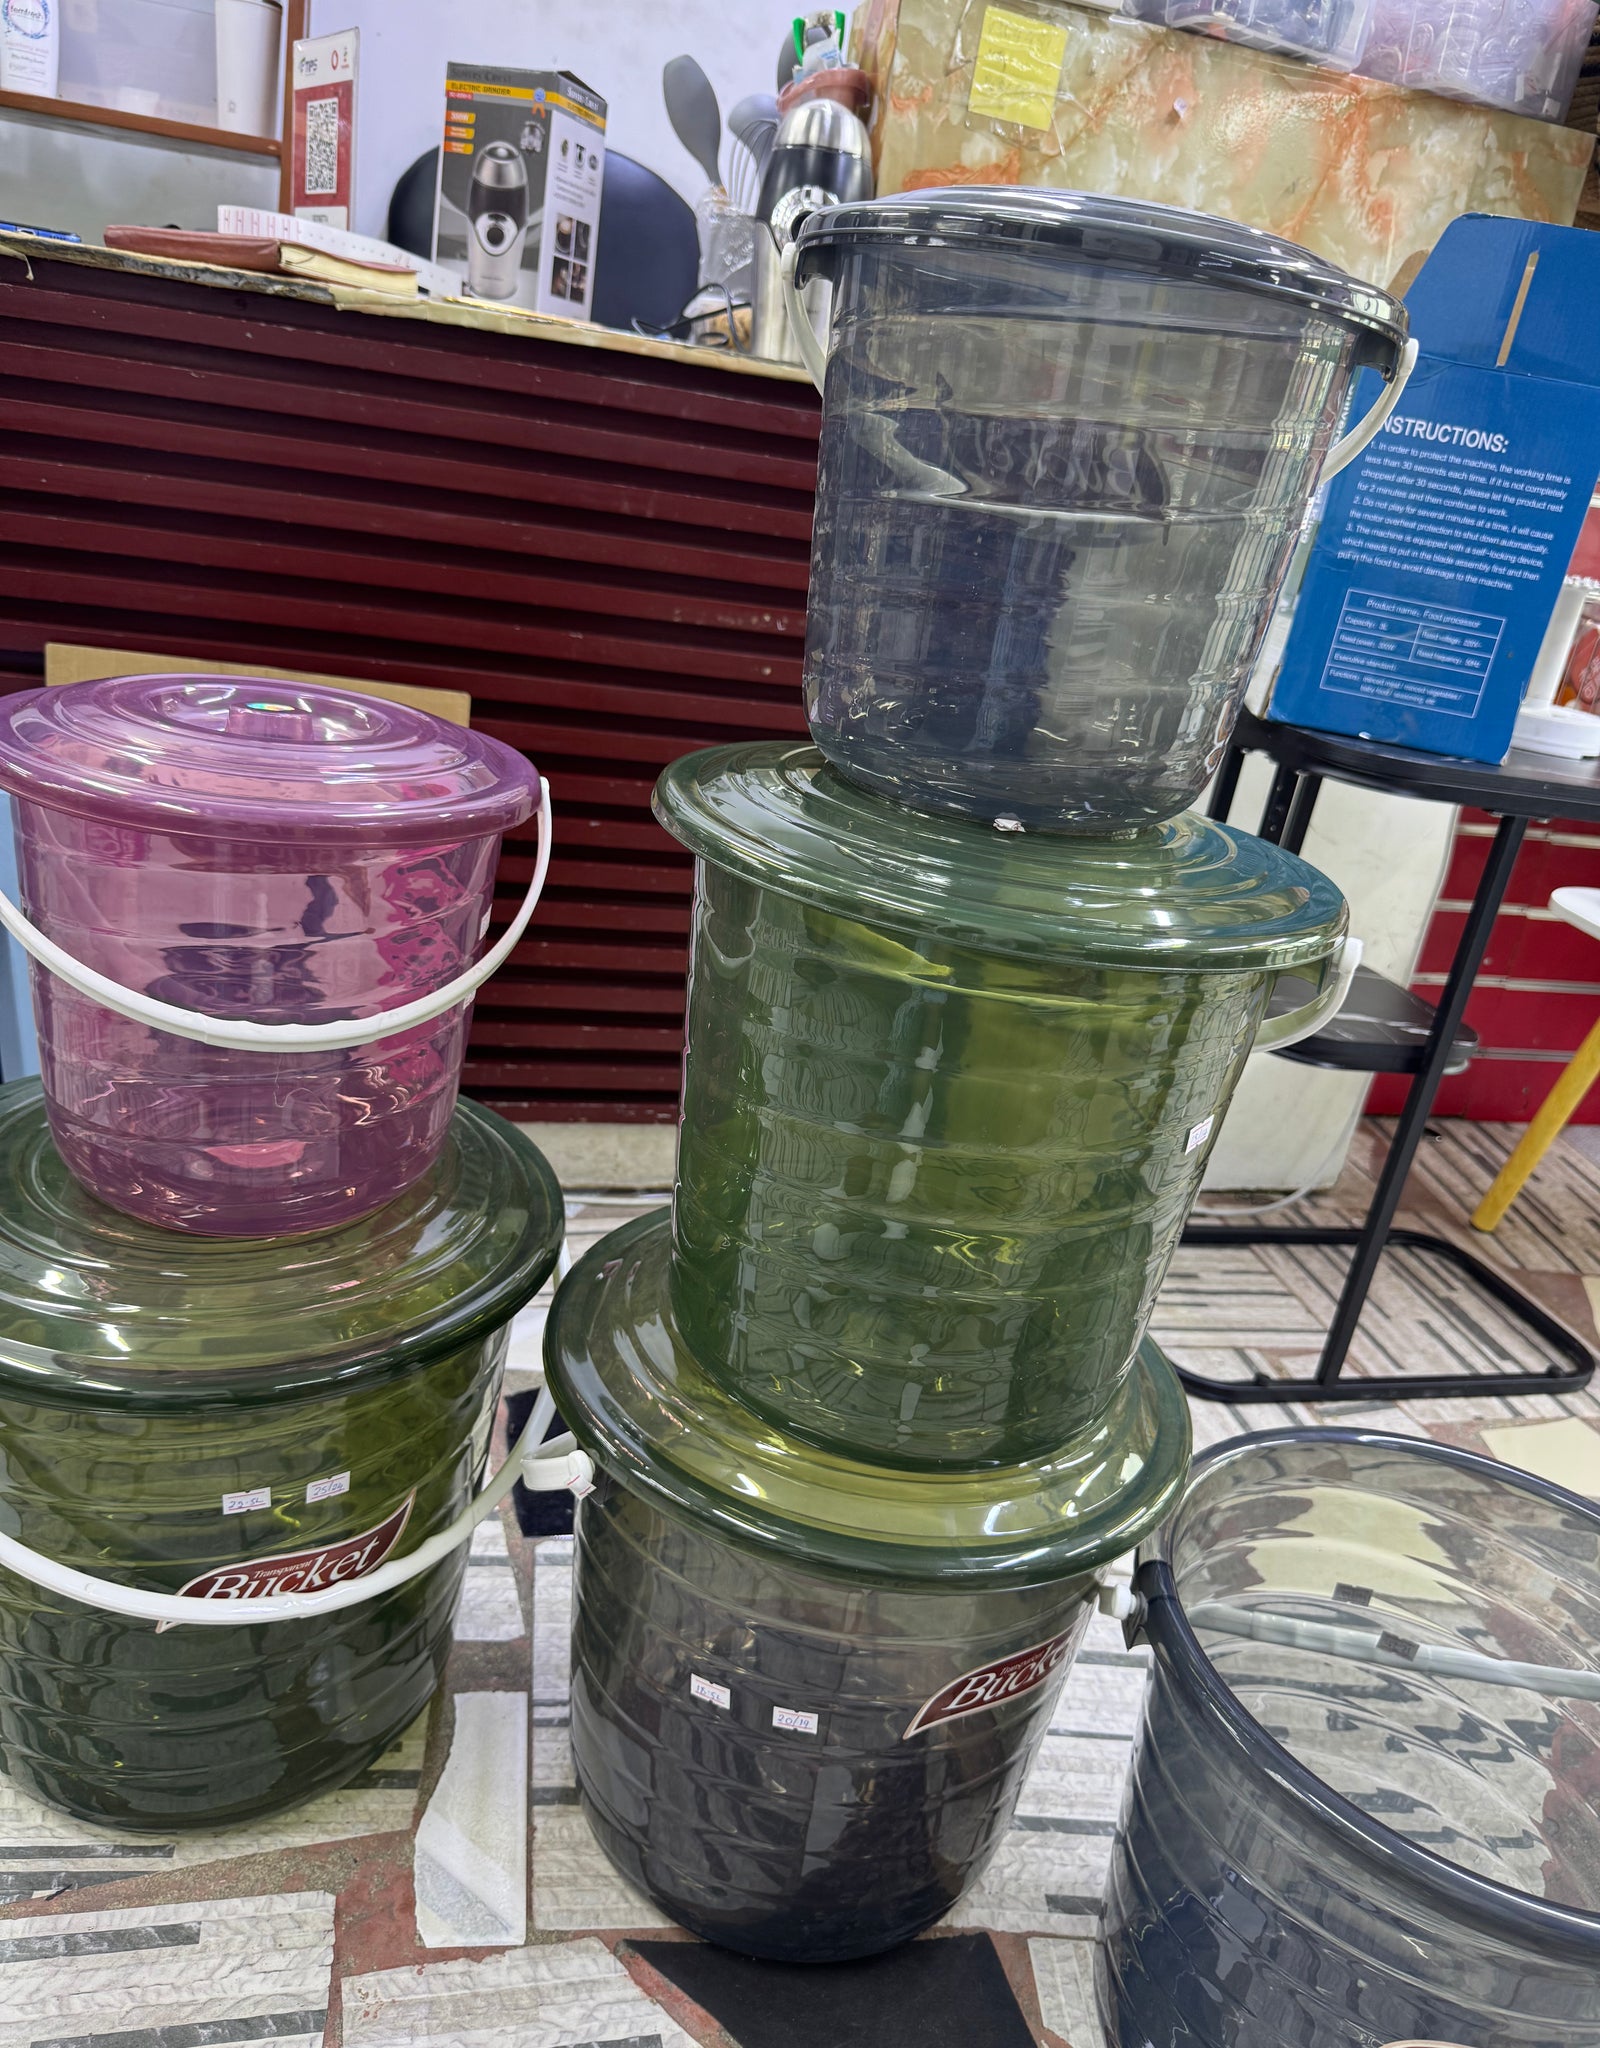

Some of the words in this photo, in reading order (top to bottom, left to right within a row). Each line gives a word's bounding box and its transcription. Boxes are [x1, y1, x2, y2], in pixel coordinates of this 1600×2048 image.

[1376, 415, 1510, 454] NSTRUCTIONS:
[1364, 453, 1383, 465] less
[1382, 457, 1402, 468] than
[1412, 464, 1448, 477] seconds
[1447, 470, 1469, 481] each
[1510, 481, 1526, 491] not
[1524, 484, 1568, 501] completely
[1387, 445, 1411, 455] order
[1418, 450, 1449, 462] protect
[1447, 455, 1462, 465] the
[1499, 463, 1514, 474] the
[1513, 468, 1546, 482] working
[1544, 472, 1564, 484] time
[1356, 480, 1370, 491] for
[1375, 486, 1408, 499] minutes
[1407, 492, 1426, 502] and
[1424, 494, 1443, 505] then
[1442, 498, 1478, 512] continue
[1360, 468, 1397, 482] chopped
[1395, 474, 1416, 485] after
[1462, 487, 1492, 500] please
[1490, 491, 1503, 502] let
[1502, 494, 1517, 504] the
[1515, 497, 1548, 510] product
[1546, 503, 1564, 513] rest
[1349, 509, 1362, 520] the
[1361, 513, 1385, 523] motor
[1383, 517, 1418, 530] overheat
[1416, 522, 1454, 536] protection
[1461, 530, 1480, 541] shut
[1478, 534, 1501, 545] down
[1374, 500, 1389, 510] not
[1387, 503, 1406, 514] play
[1404, 504, 1418, 515] for
[1416, 508, 1446, 520] several
[1444, 513, 1476, 527] minutes
[1517, 527, 1531, 536] will
[1529, 530, 1554, 541] cause
[1341, 537, 1364, 548] which
[1363, 541, 1389, 553] needs
[1396, 548, 1412, 557] put
[1418, 550, 1433, 561] the
[1432, 553, 1455, 565] blade
[1454, 559, 1492, 573] assembly
[1490, 563, 1508, 575] first
[1505, 568, 1523, 578] and
[1521, 570, 1540, 581] then
[1355, 524, 1372, 536] The
[1370, 529, 1405, 542] machine
[1411, 536, 1449, 550] equipped
[1447, 543, 1466, 552] with
[1471, 547, 1518, 564] self-locking
[1336, 550, 1353, 560] put
[1358, 553, 1374, 564] the
[1373, 556, 1393, 568] food
[1400, 563, 1425, 574] avoid
[1422, 565, 1456, 580] damage
[1464, 574, 1479, 584] the
[204, 1536, 380, 1599] Bucket
